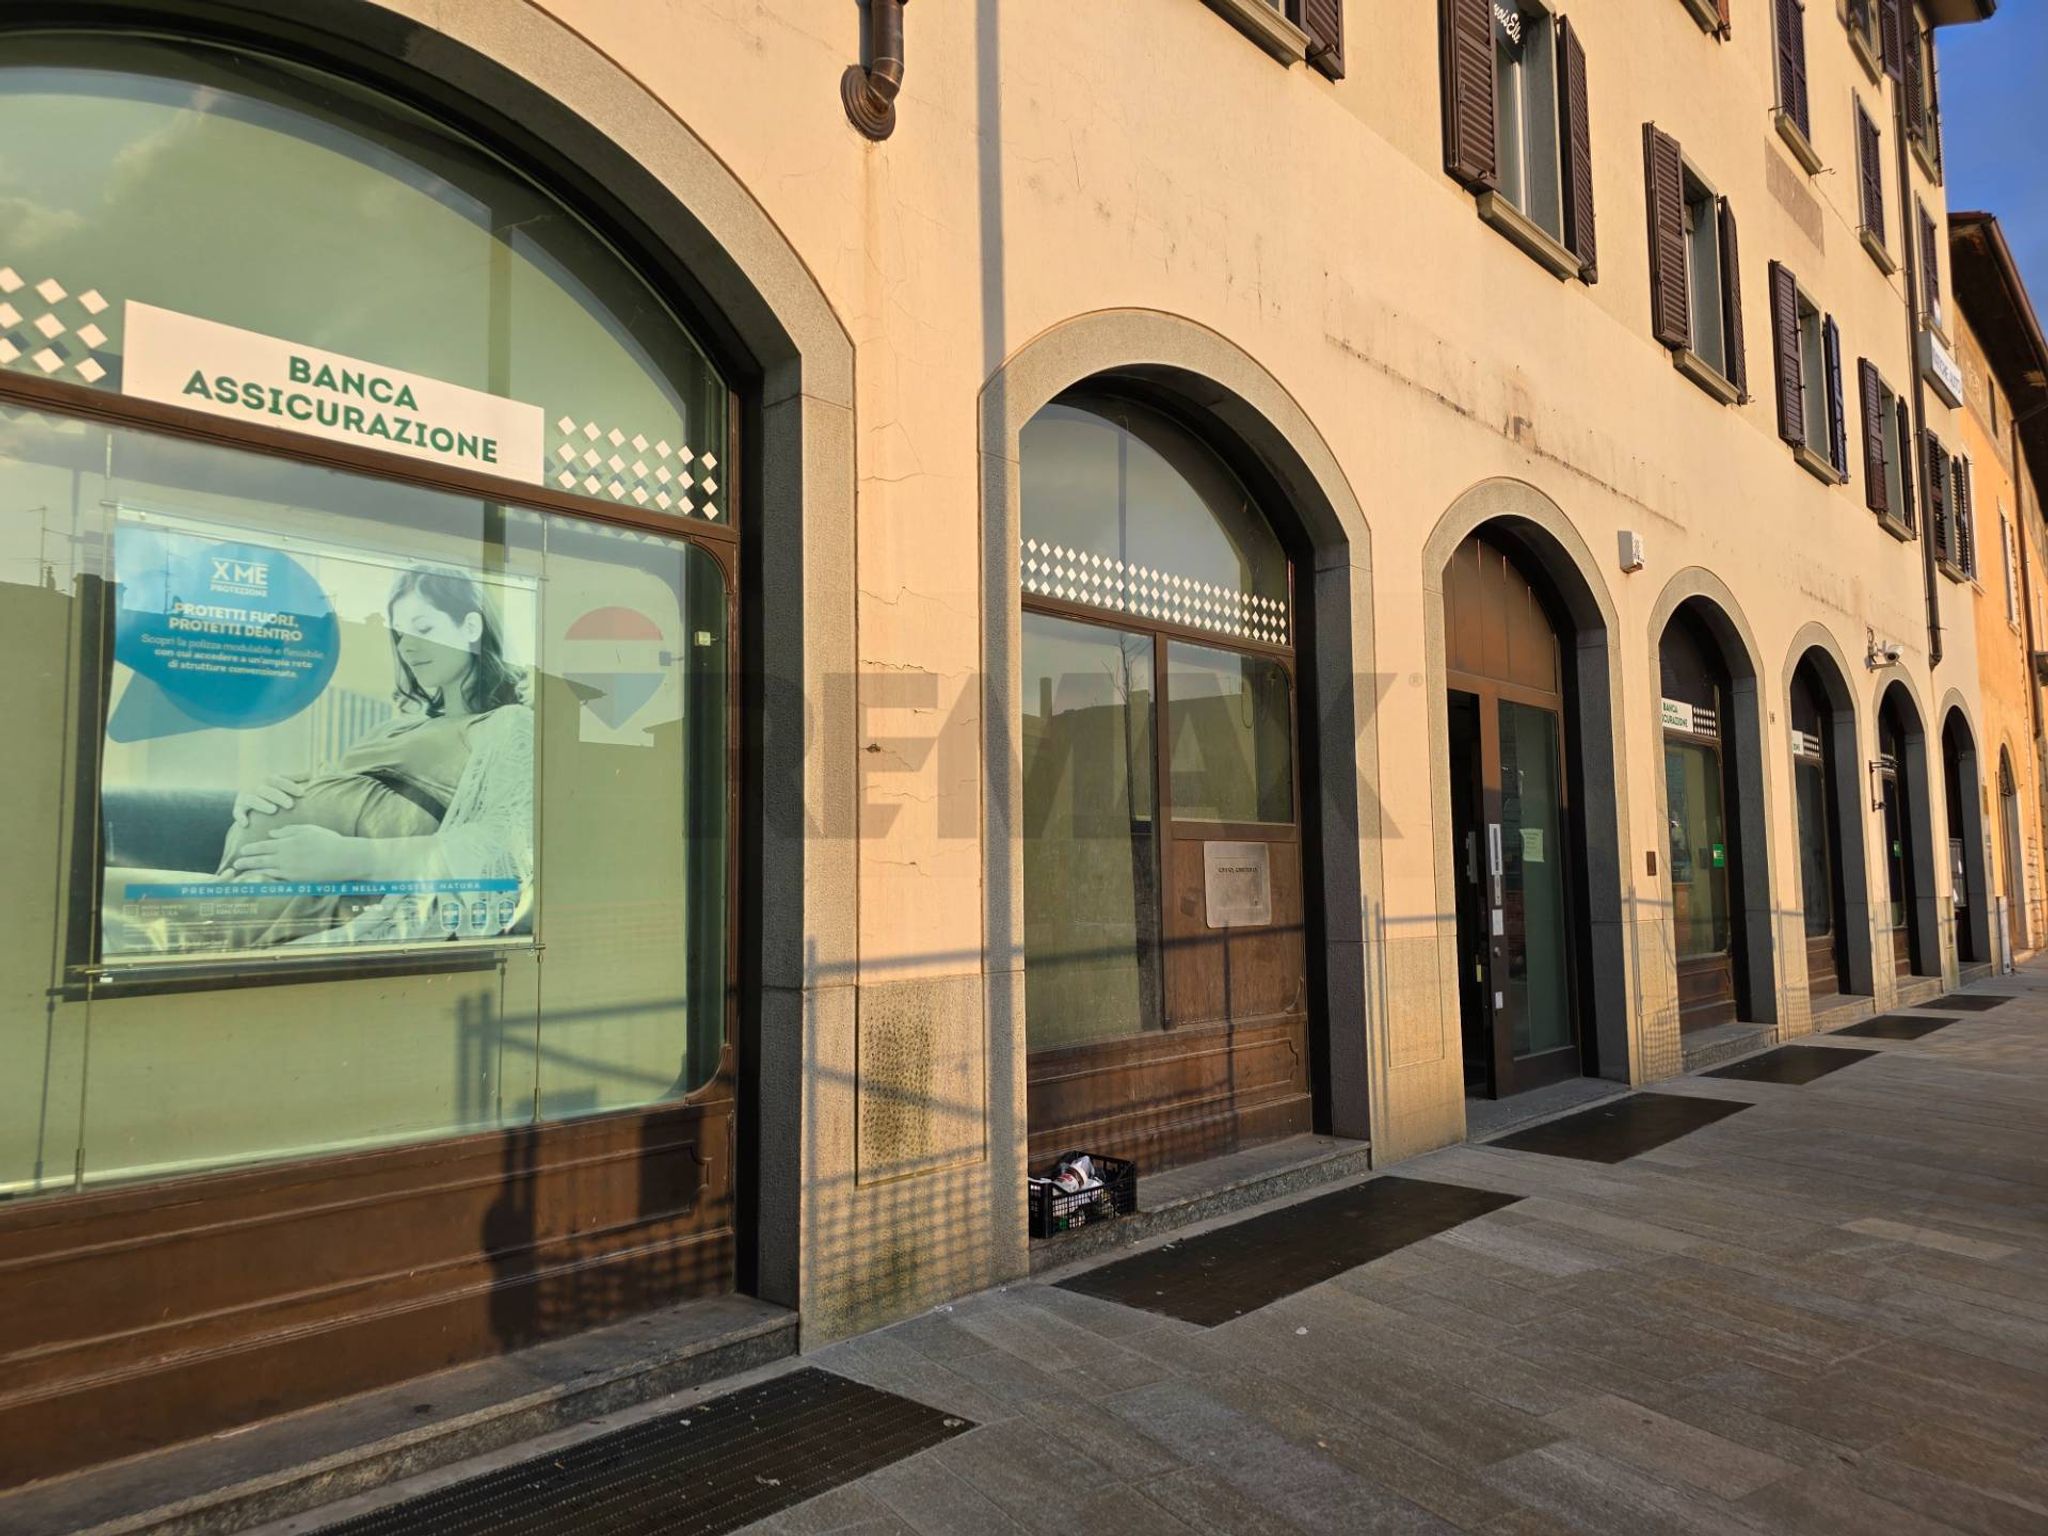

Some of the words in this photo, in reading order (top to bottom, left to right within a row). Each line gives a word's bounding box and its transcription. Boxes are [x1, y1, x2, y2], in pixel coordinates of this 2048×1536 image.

[289, 356, 419, 412] BANCA
[183, 370, 498, 464] ASSICURAZIONE
[210, 585, 268, 597] PROTEZIONE
[173, 603, 247, 622] PROTETTI
[169, 617, 241, 636] PROTETTI
[245, 624, 303, 641] DENTRO
[181, 885, 255, 896] PRENDERCI
[260, 885, 293, 894] CURA
[298, 885, 311, 894] DI
[316, 884, 336, 894] VOI
[352, 884, 386, 893] NELLA
[439, 881, 481, 890] NATURA
